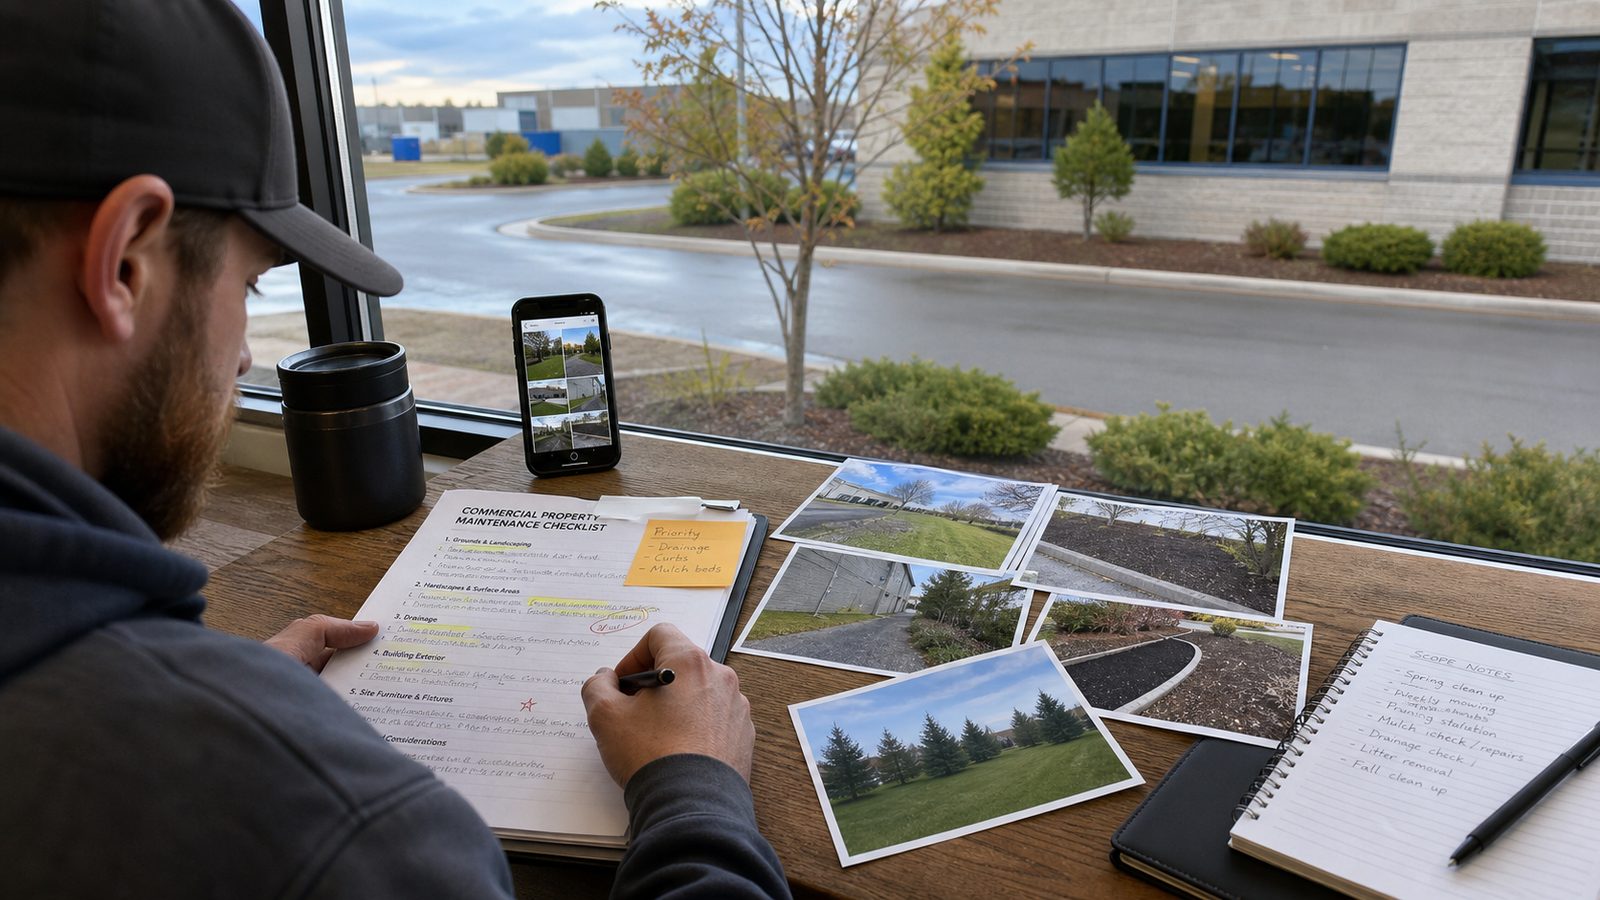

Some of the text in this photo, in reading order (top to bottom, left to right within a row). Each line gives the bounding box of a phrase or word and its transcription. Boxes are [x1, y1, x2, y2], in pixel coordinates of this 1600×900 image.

[461, 506, 600, 522] COMMERCIAL PROPERTY
[455, 516, 607, 532] MAINTENANCE CHECKLIST
[654, 526, 701, 540] Priority
[659, 542, 711, 554] Drainage
[654, 553, 688, 562] Curbs
[649, 563, 721, 573] Mulch beds
[403, 614, 438, 623] Drainage
[382, 650, 414, 660] Building
[415, 652, 446, 660] Exterior
[1409, 650, 1513, 679] SCOPE NOTES
[1404, 670, 1444, 689] Spring
[1452, 682, 1483, 696] clean
[359, 688, 375, 696] Site
[376, 690, 413, 699] Furniture
[1386, 701, 1434, 725] Pruning
[1449, 698, 1496, 716] mowing
[385, 734, 447, 746] Considerations
[1369, 728, 1422, 753] Drainage
[1428, 748, 1465, 764] check
[1377, 715, 1417, 732] Mulch
[1480, 744, 1525, 762] repairs
[1360, 743, 1454, 778] Litter removal
[1352, 759, 1447, 796] Fall clean up
